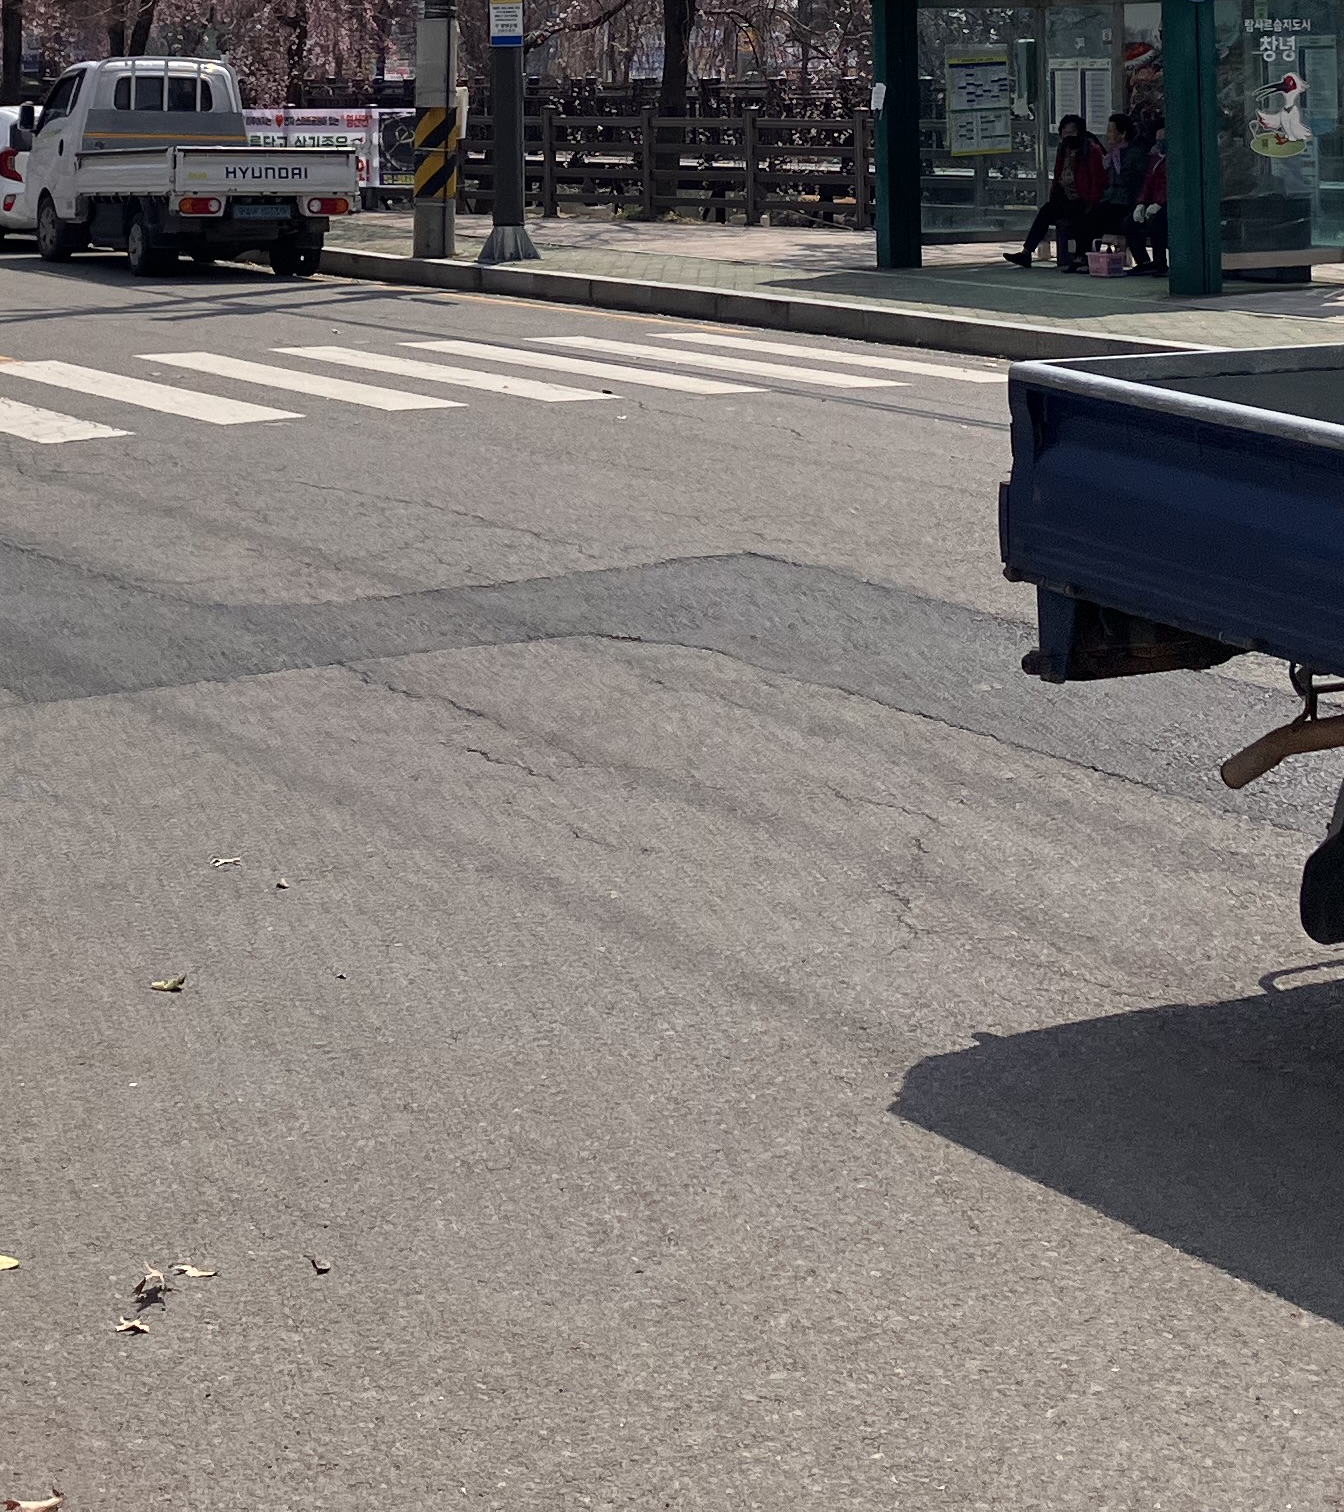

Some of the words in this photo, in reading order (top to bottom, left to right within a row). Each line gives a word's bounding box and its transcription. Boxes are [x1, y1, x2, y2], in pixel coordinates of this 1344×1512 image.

[1245, 19, 1311, 32] 람사르습지도시
[1260, 35, 1296, 62] 창녕
[226, 167, 309, 180] HYUNDAI
